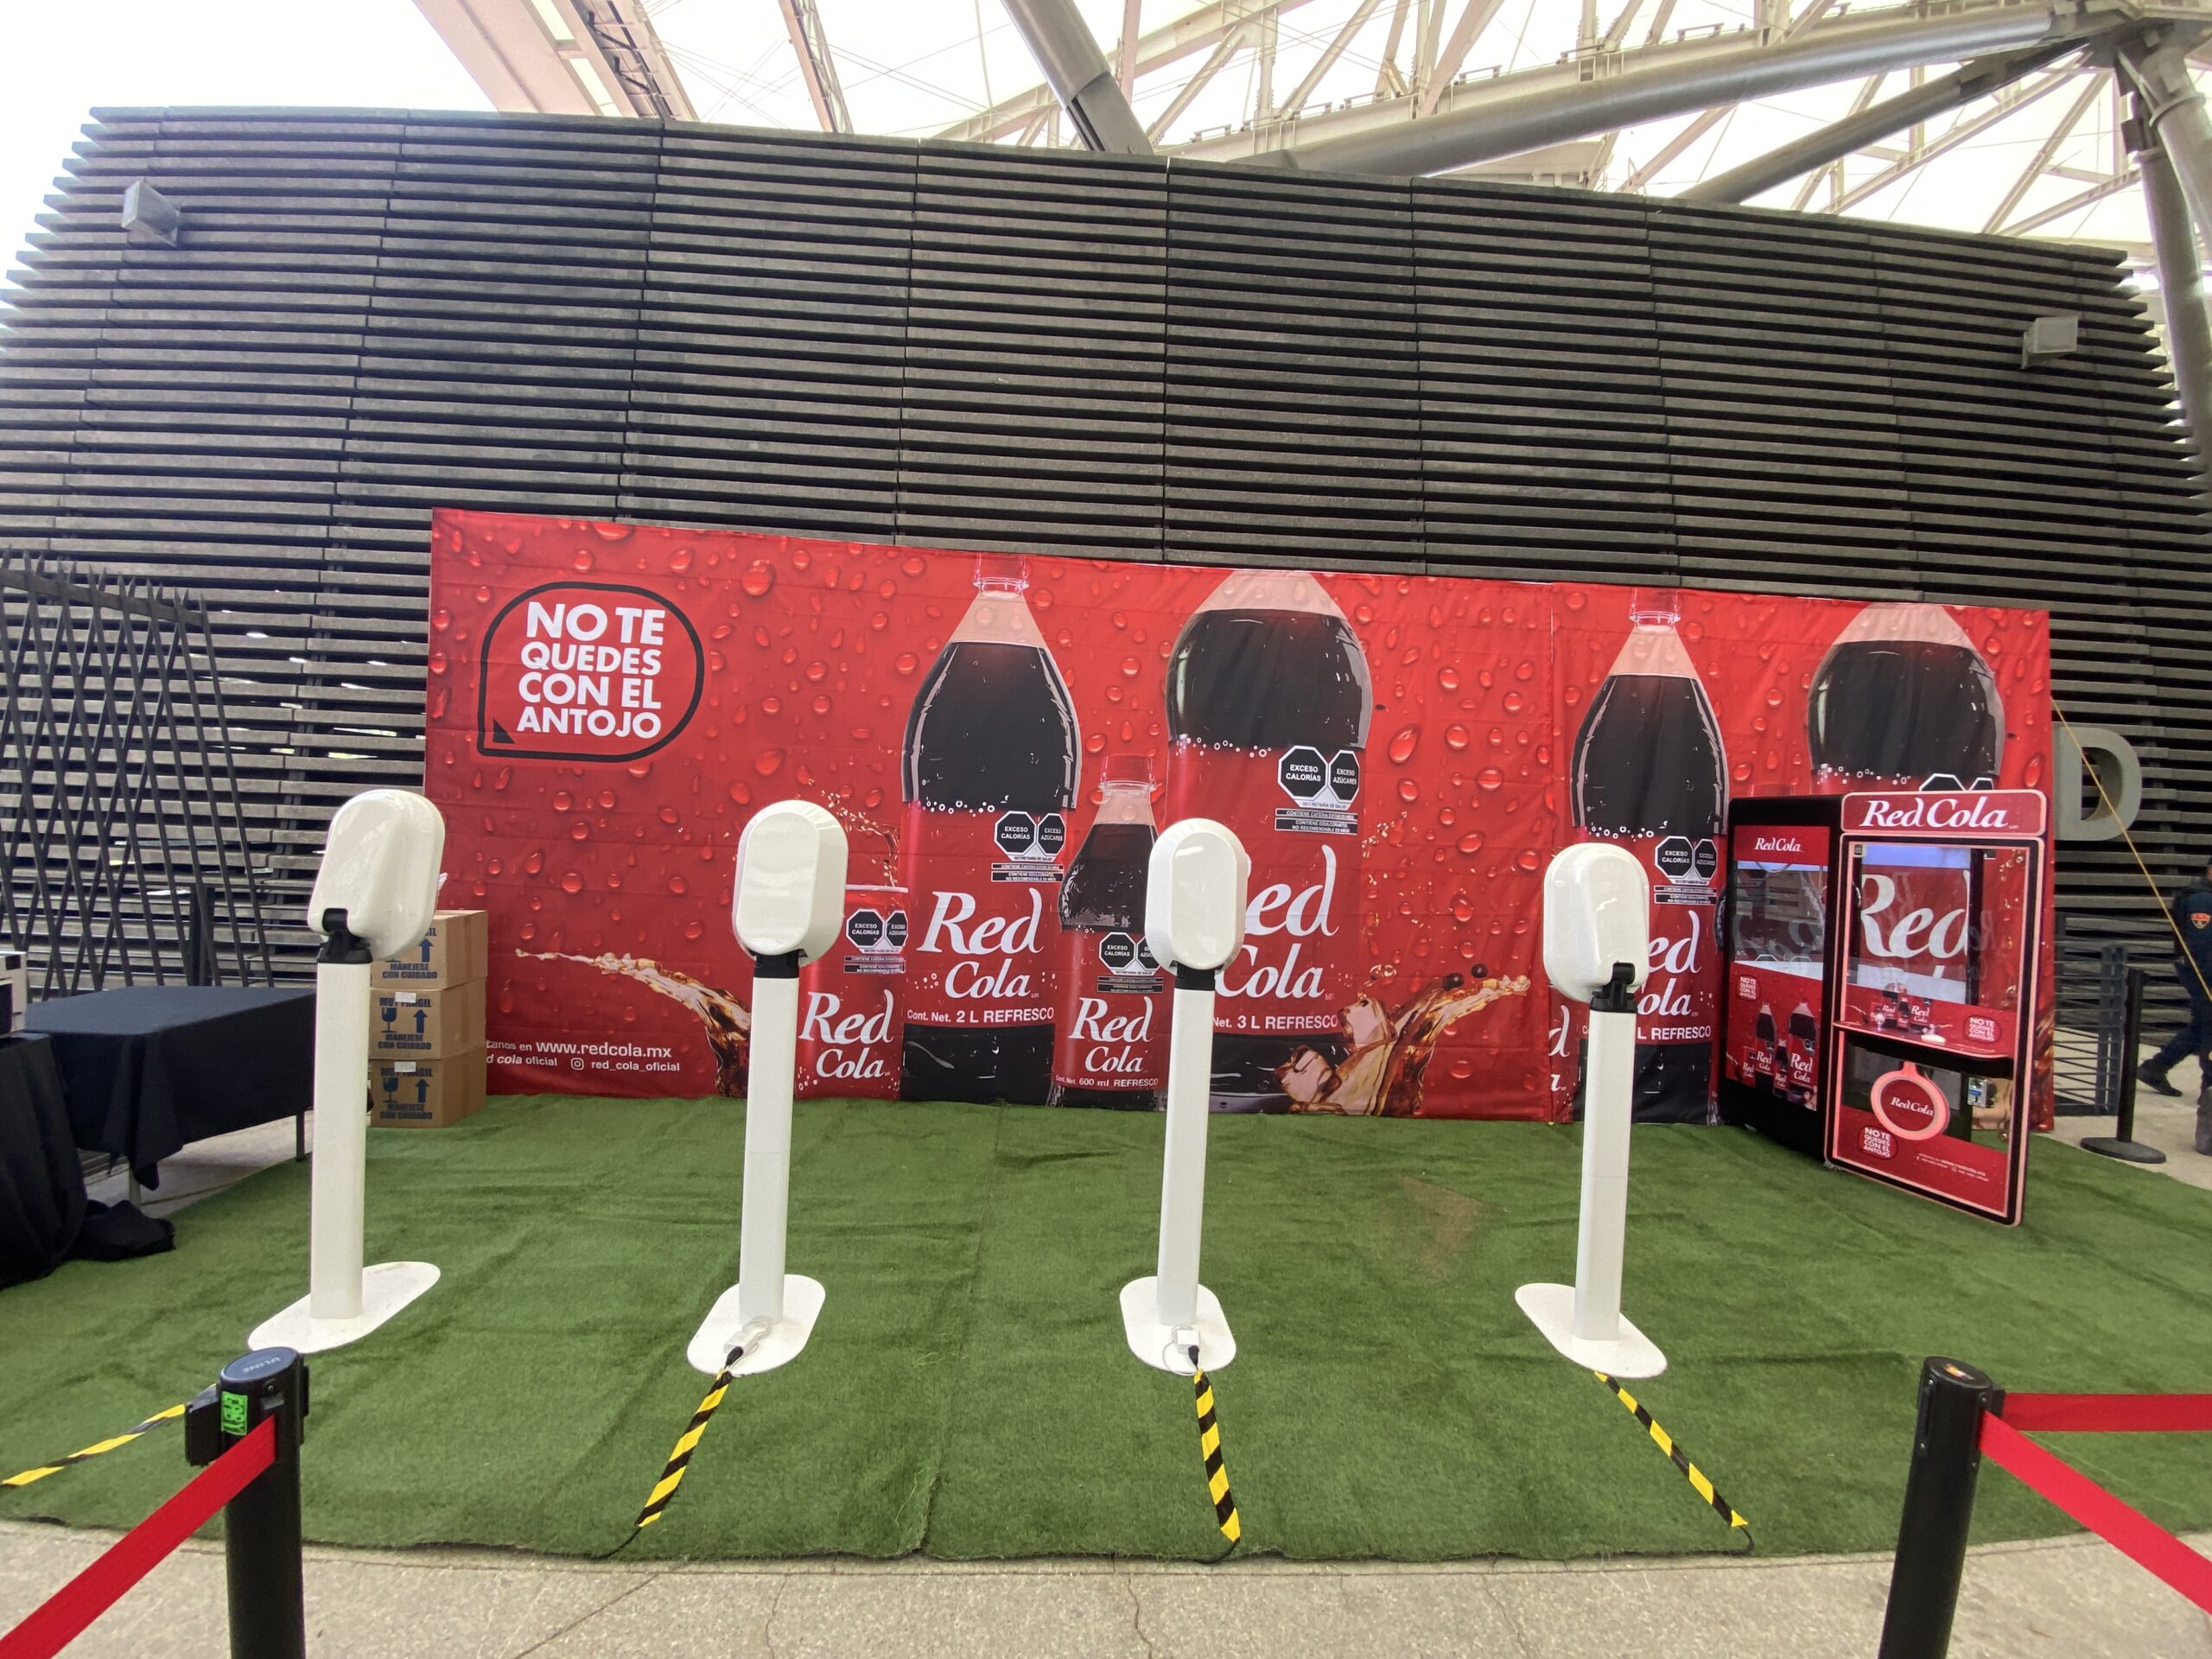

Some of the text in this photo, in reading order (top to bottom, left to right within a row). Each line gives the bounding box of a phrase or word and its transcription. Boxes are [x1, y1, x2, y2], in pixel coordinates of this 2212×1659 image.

[526, 601, 666, 645] NO TE
[520, 641, 662, 676] QUEDES
[518, 672, 662, 709] CON EL
[516, 706, 662, 739] ANTOJO
[1289, 764, 1319, 772] EXCESO
[1285, 772, 1321, 782] CALORÍAS
[1332, 776, 1357, 785] AZÚCARES
[2054, 726, 2143, 841] D
[1244, 844, 1340, 938] ed
[916, 887, 1045, 956] Red
[1648, 910, 1702, 975] ed
[945, 958, 1032, 999] Cola
[1636, 977, 1692, 1016] ola
[798, 989, 893, 1045] Red
[906, 1007, 1054, 1023] Cont. Net. 2 L REFRESCO
[1068, 995, 1154, 1043] Red
[1910, 1005, 1930, 1017] Red
[1237, 1015, 1247, 1028] 3
[1251, 1015, 1261, 1029] L
[1265, 1014, 1338, 1030] REFRESCO
[1969, 1017, 1995, 1027] NO TE
[1637, 1026, 1712, 1039] L REFRESCO
[519, 1043, 532, 1052] en
[497, 1053, 523, 1065] cola
[525, 1055, 558, 1066] oficial
[591, 1059, 680, 1072] red_cola_oficial
[816, 1047, 886, 1079] Cola
[1084, 1045, 1144, 1072] Cola
[1757, 1051, 1772, 1065] Red
[1789, 1052, 1813, 1073] Red
[1078, 1077, 1095, 1086] 600
[1096, 1078, 1109, 1087] ml
[1113, 1077, 1159, 1088] REFRESCO
[1793, 1070, 1811, 1084] Cola
[1864, 1127, 1891, 1141] NO TE
[1864, 1134, 1891, 1147] QUEDES
[1863, 1145, 1891, 1158] ANTOJO
[1864, 1140, 1891, 1153] CON EL
